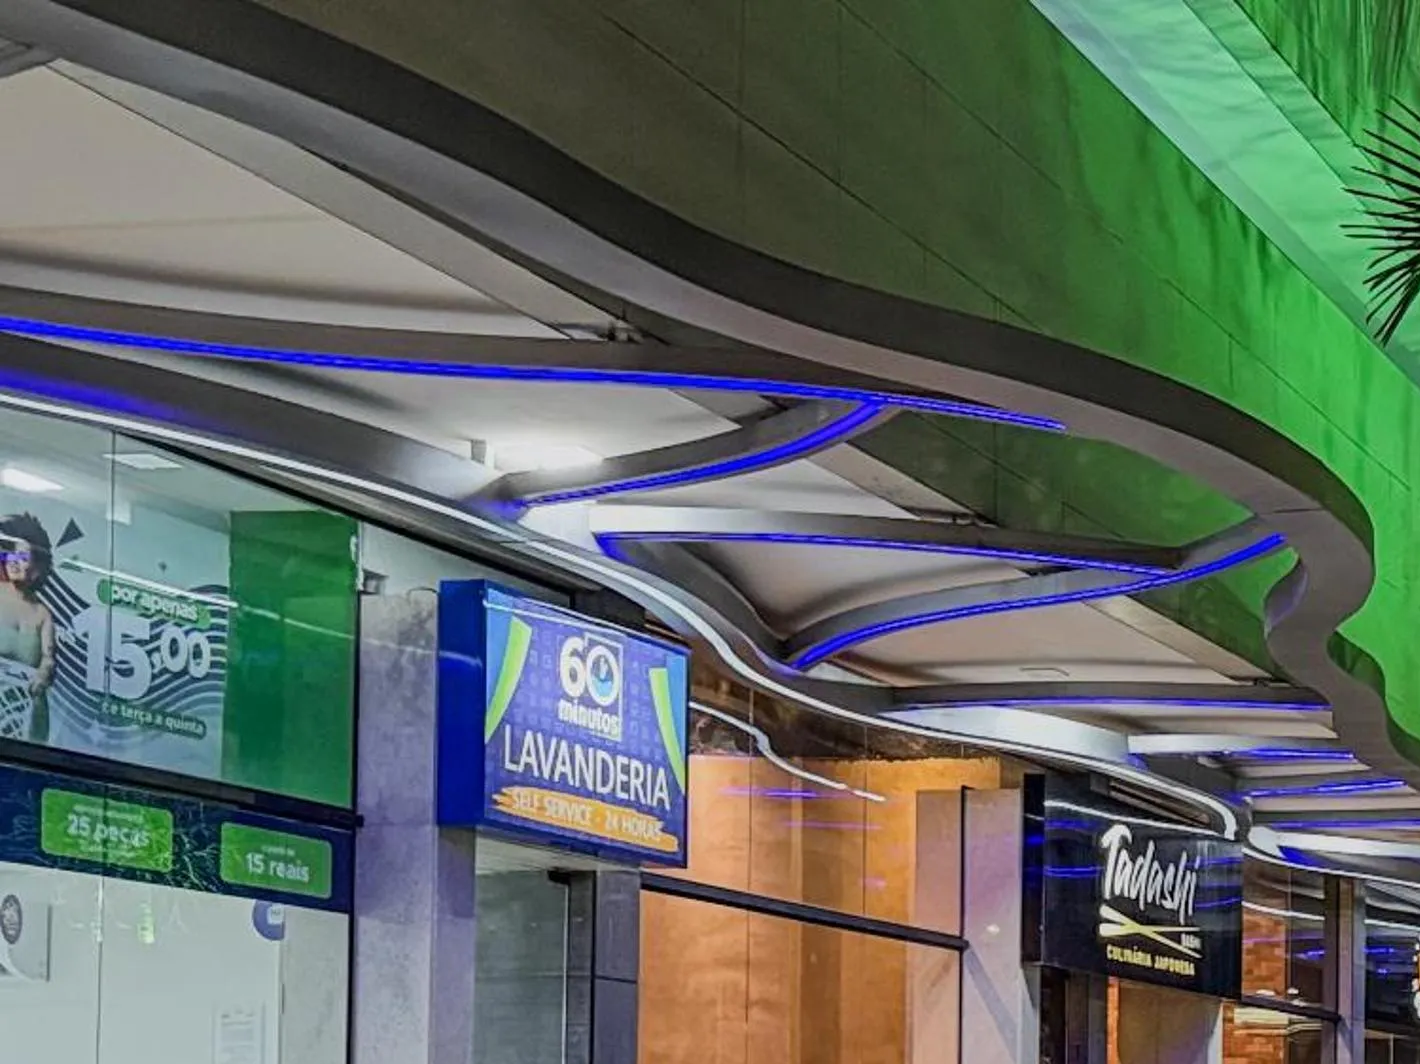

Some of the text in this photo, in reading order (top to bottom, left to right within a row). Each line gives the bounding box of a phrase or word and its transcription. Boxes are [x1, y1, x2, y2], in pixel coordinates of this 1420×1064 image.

[112, 584, 198, 620] por apenas
[71, 604, 211, 700] 15,00
[560, 636, 620, 706] 60
[165, 715, 204, 734] quinta
[558, 699, 621, 736] minutos
[504, 724, 672, 812] LAVANDERIA
[545, 797, 591, 825] SERVICE
[246, 852, 310, 884] 15 reais
[1101, 824, 1201, 926] Tadashi
